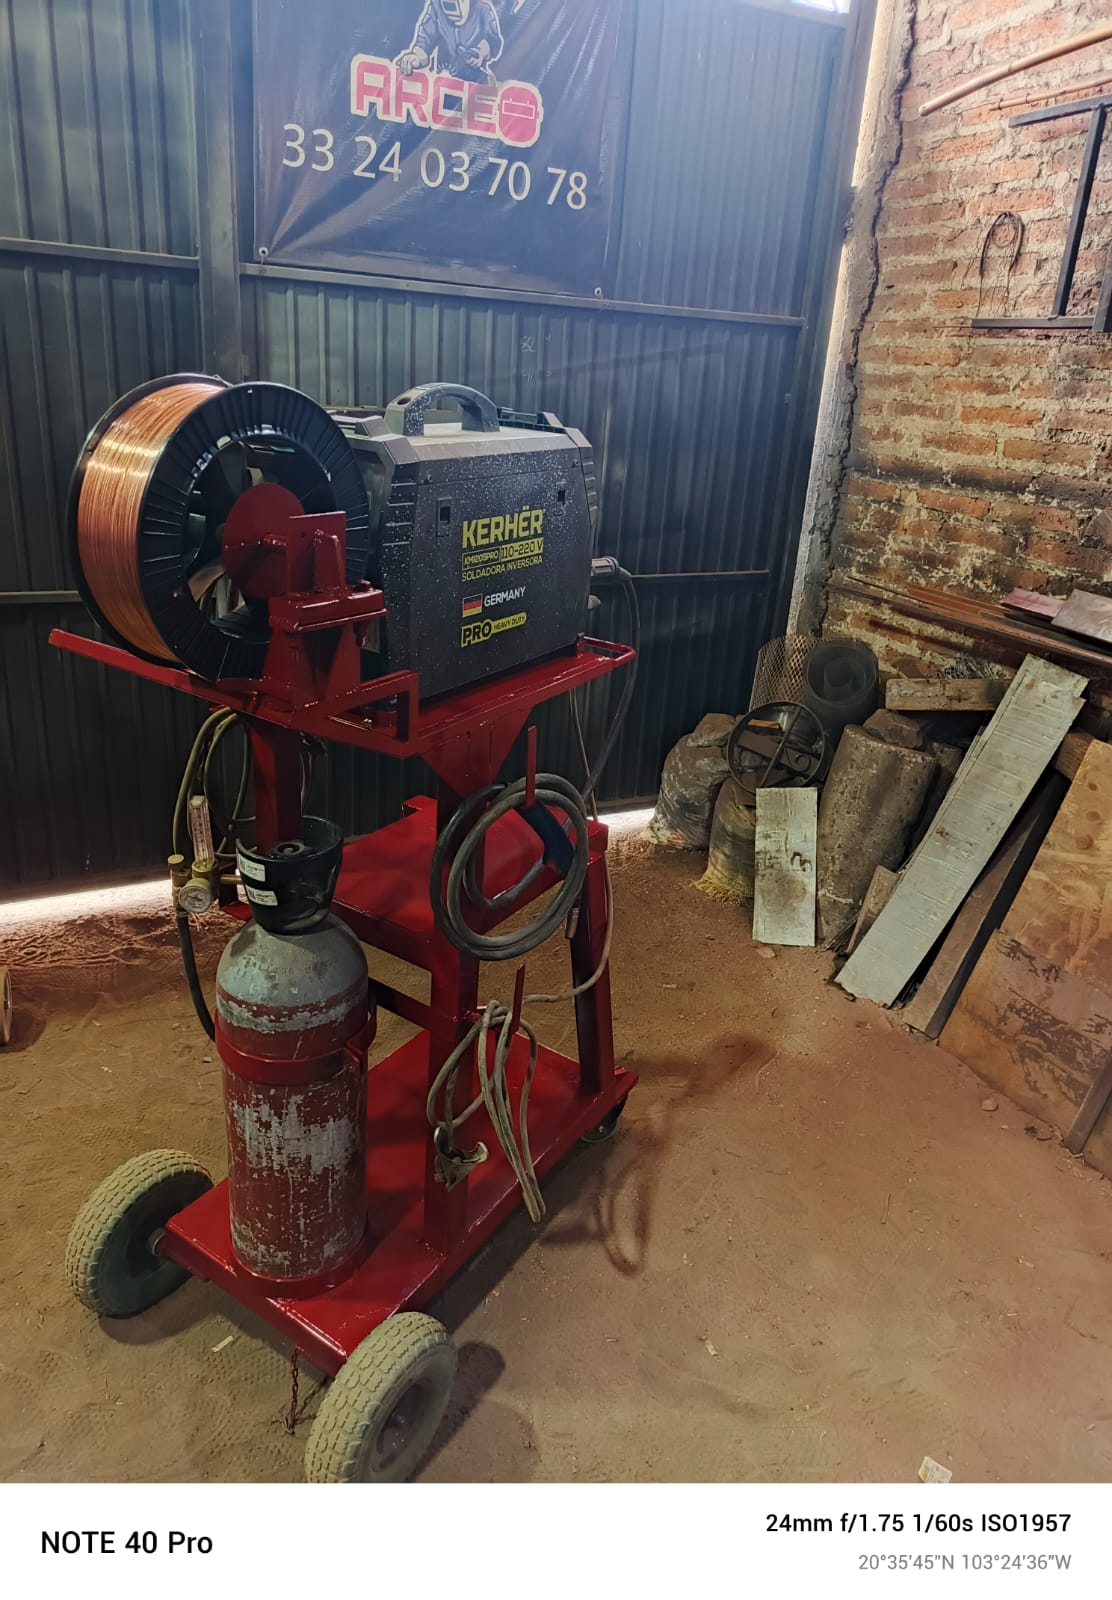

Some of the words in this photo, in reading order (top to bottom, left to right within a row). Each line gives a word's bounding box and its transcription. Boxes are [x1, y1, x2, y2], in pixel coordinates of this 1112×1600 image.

[283, 123, 334, 172] 33
[353, 135, 402, 182] 24
[420, 148, 471, 192] 03
[488, 156, 531, 201] 70
[546, 167, 588, 210] 78
[462, 505, 544, 549] KERHËR
[501, 540, 536, 559] 110-220
[537, 538, 544, 551] V
[462, 564, 505, 582] SOLDADORA
[506, 555, 543, 571] INVERSORA
[484, 586, 526, 607] GERMANY
[462, 620, 492, 647] PRO
[493, 620, 511, 631] HEAVY
[511, 616, 526, 626] DUTY
